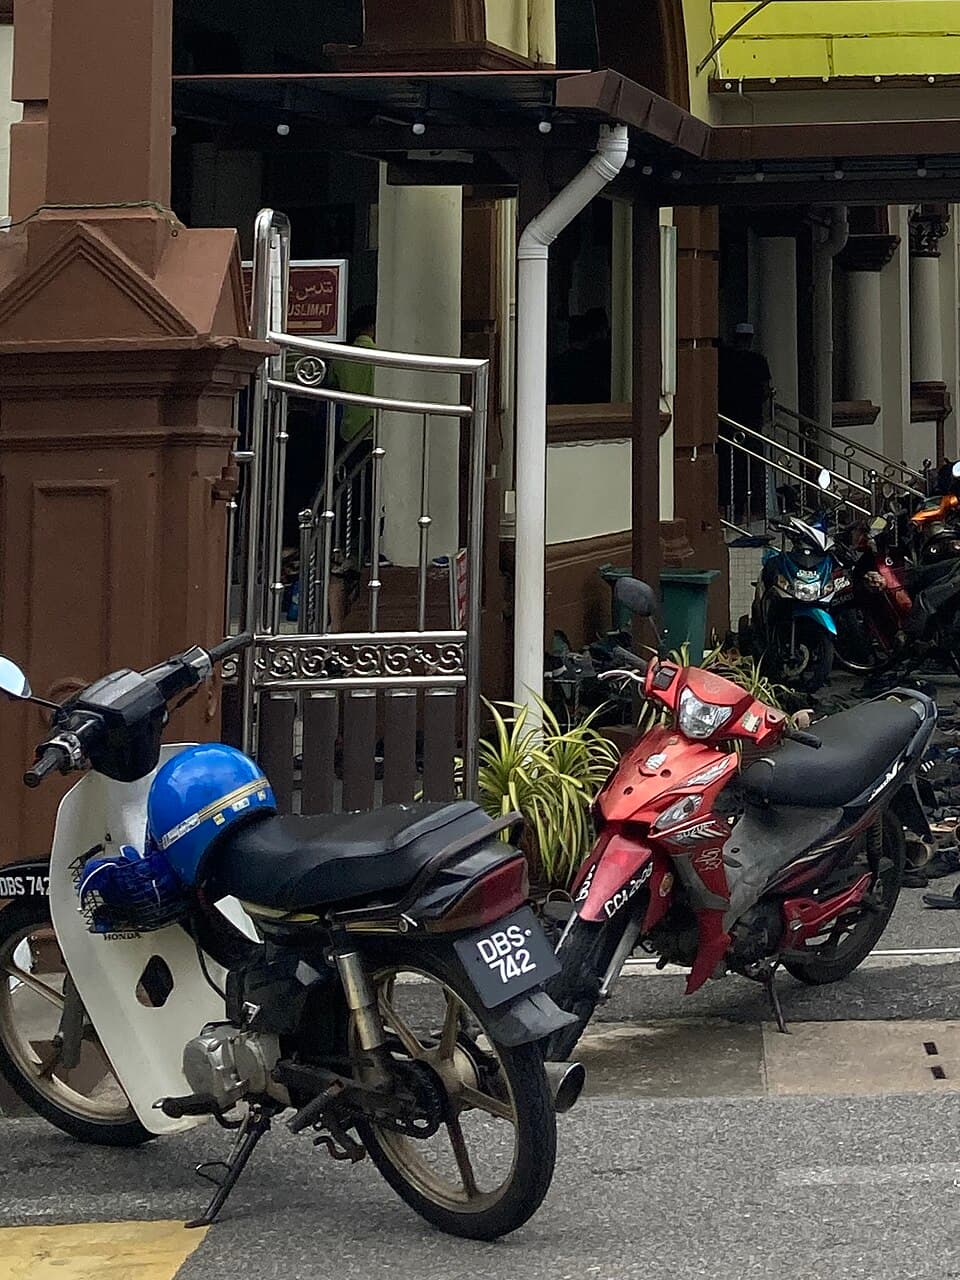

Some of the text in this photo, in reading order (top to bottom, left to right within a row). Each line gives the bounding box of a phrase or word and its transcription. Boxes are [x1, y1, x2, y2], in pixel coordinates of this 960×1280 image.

[287, 303, 332, 316] USLIMAT
[0, 876, 50, 896] DBS 742
[103, 932, 142, 941] HONDA
[477, 925, 525, 964] DBS
[489, 949, 536, 983] 742
